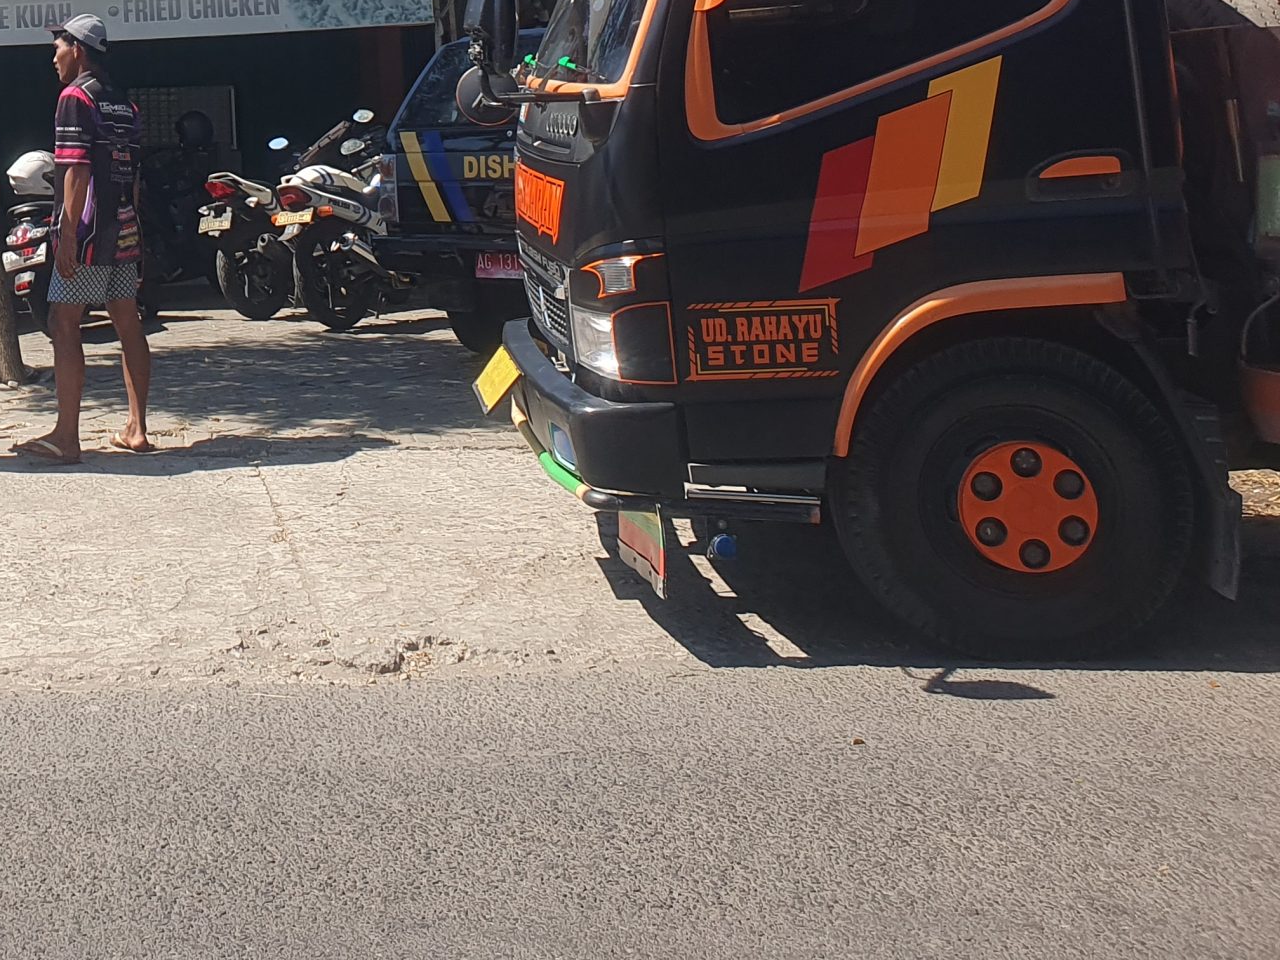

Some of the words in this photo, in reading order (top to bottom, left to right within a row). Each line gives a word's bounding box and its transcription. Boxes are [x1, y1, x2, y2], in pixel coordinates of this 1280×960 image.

[15, 2, 71, 29] KUAH
[477, 253, 491, 269] AG
[700, 317, 732, 343] UD.
[736, 314, 822, 342] RAHAYU
[707, 342, 819, 366] STONE
